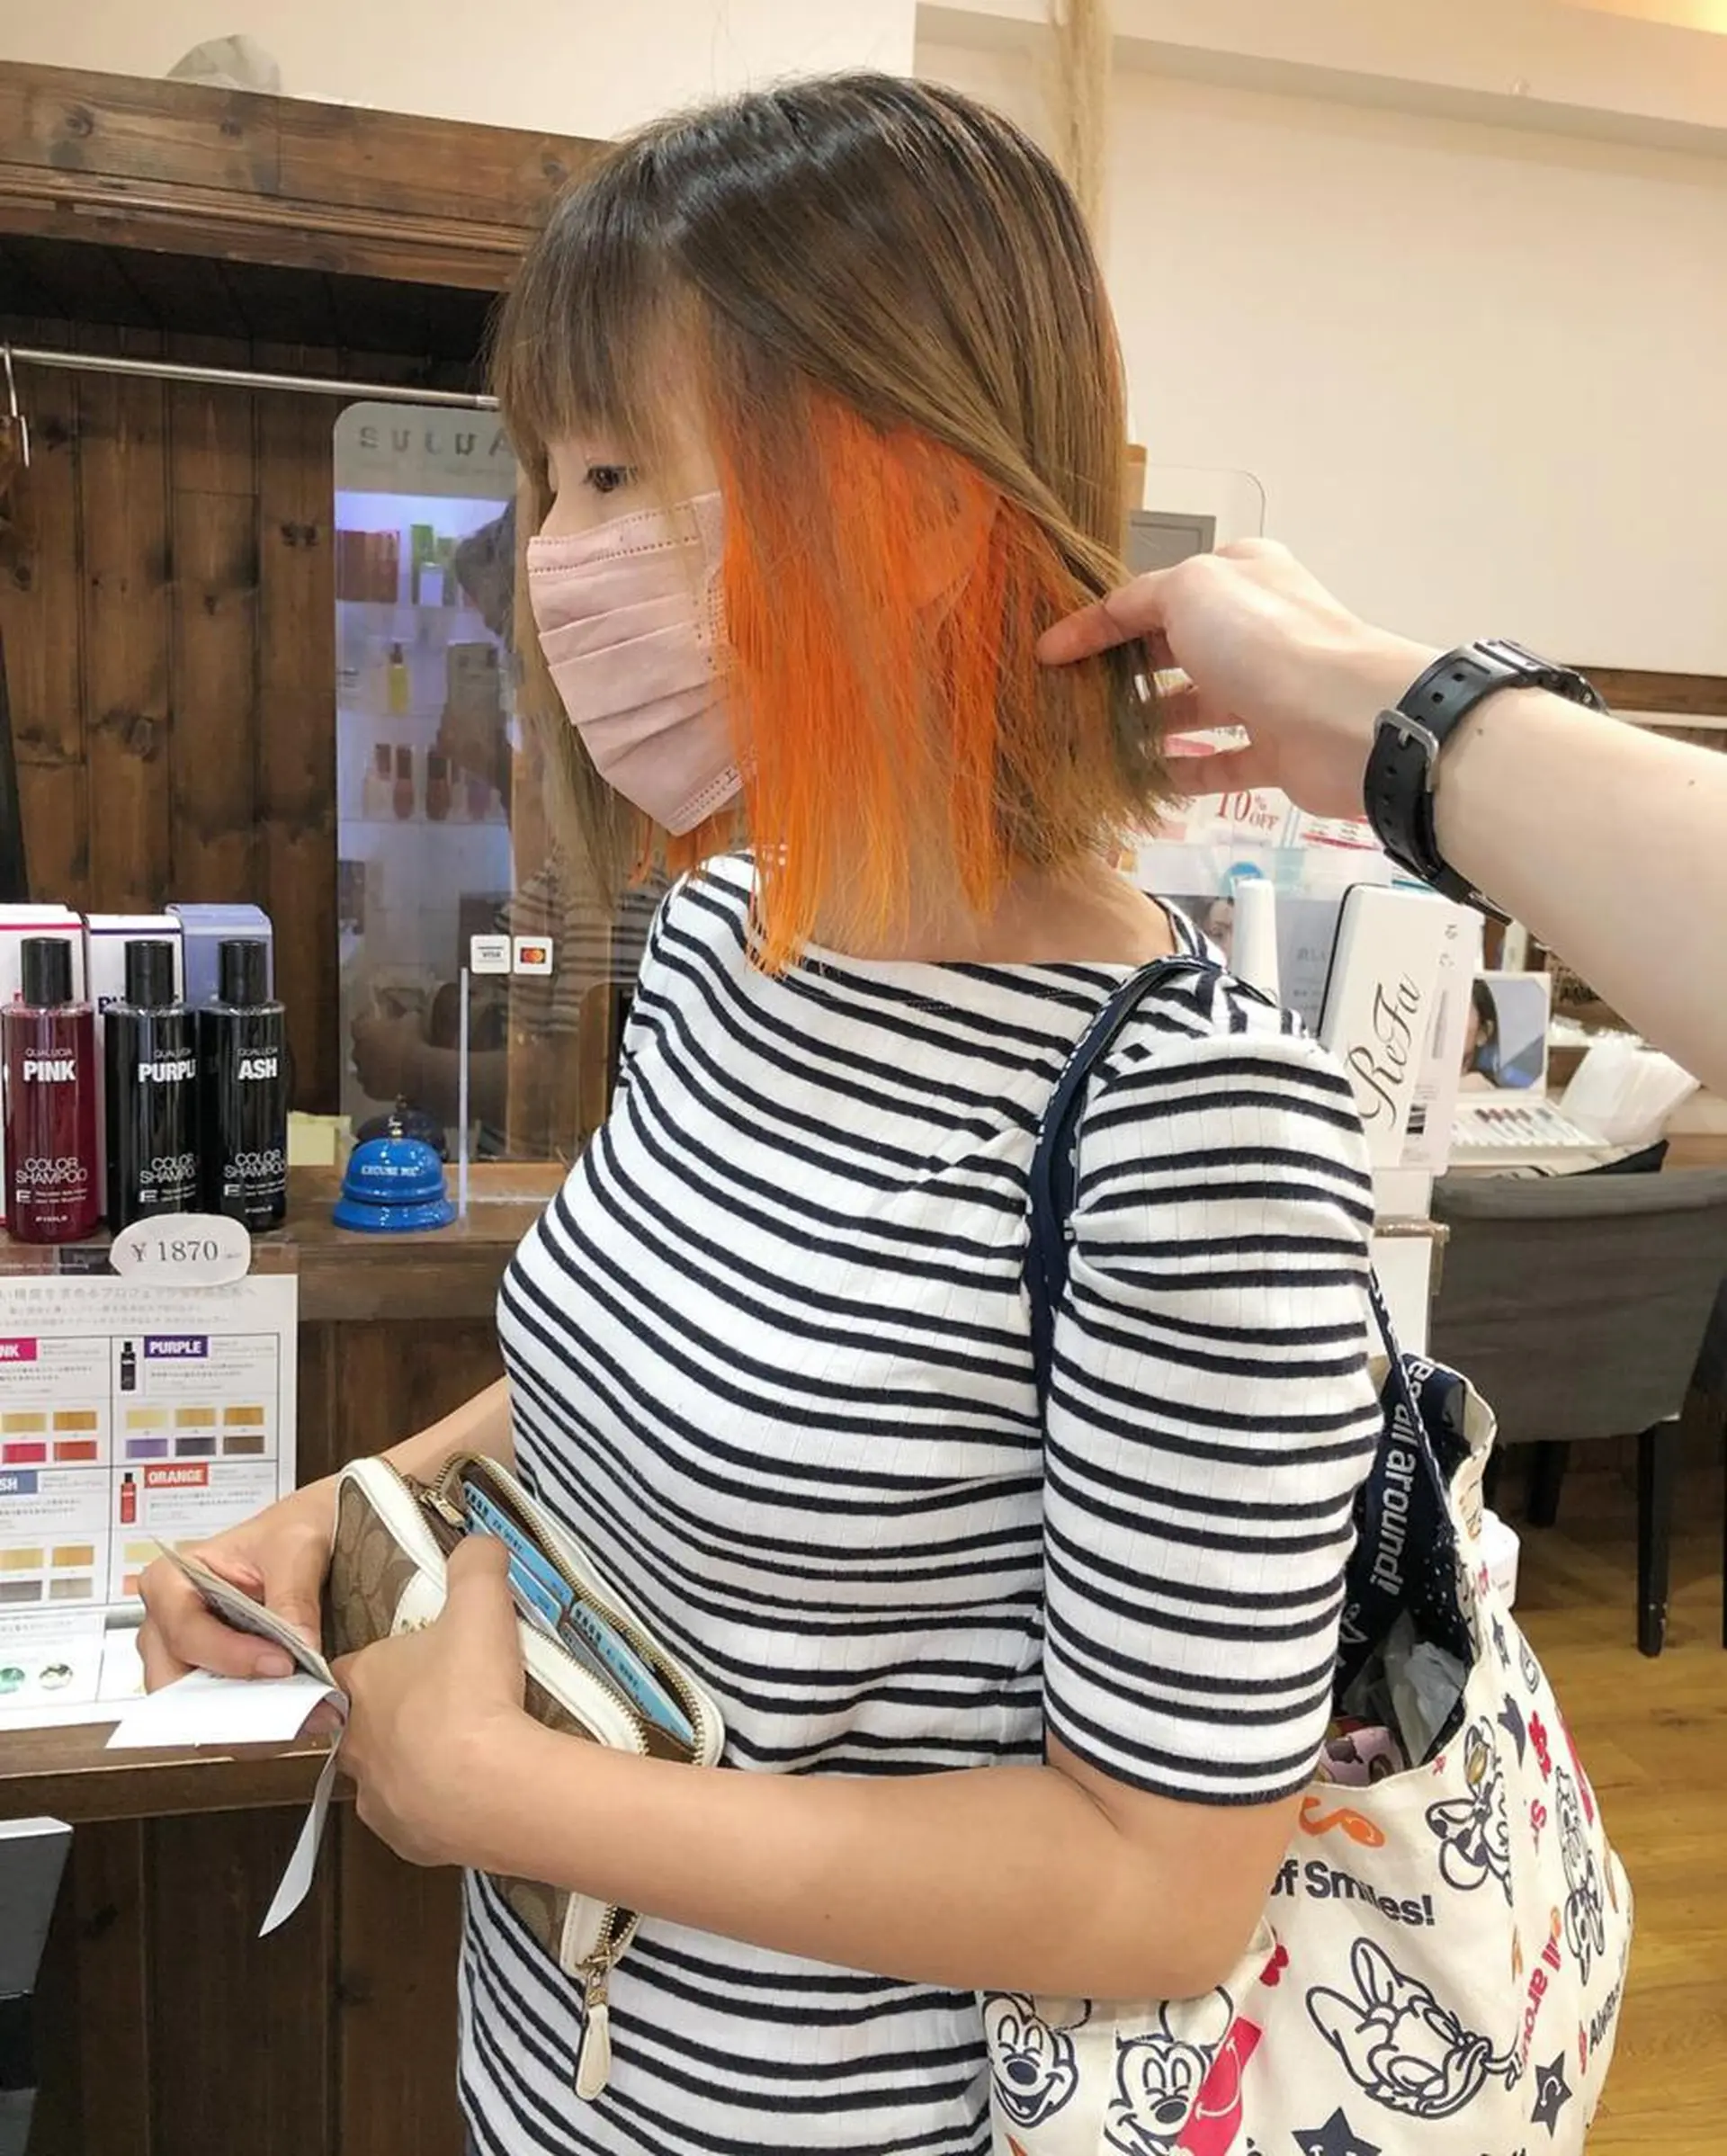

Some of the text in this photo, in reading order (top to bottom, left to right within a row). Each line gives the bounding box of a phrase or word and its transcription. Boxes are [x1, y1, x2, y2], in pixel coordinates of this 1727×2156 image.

[23, 1060, 76, 1082] PINK
[237, 1058, 278, 1079] ASH
[24, 1157, 78, 1172] COLOR
[15, 1167, 87, 1184] SHAMPOO
[157, 1240, 219, 1261] 1870
[149, 1340, 202, 1355] PURPLE
[148, 1469, 203, 1485] ORANGE
[1370, 1448, 1417, 1596] around!
